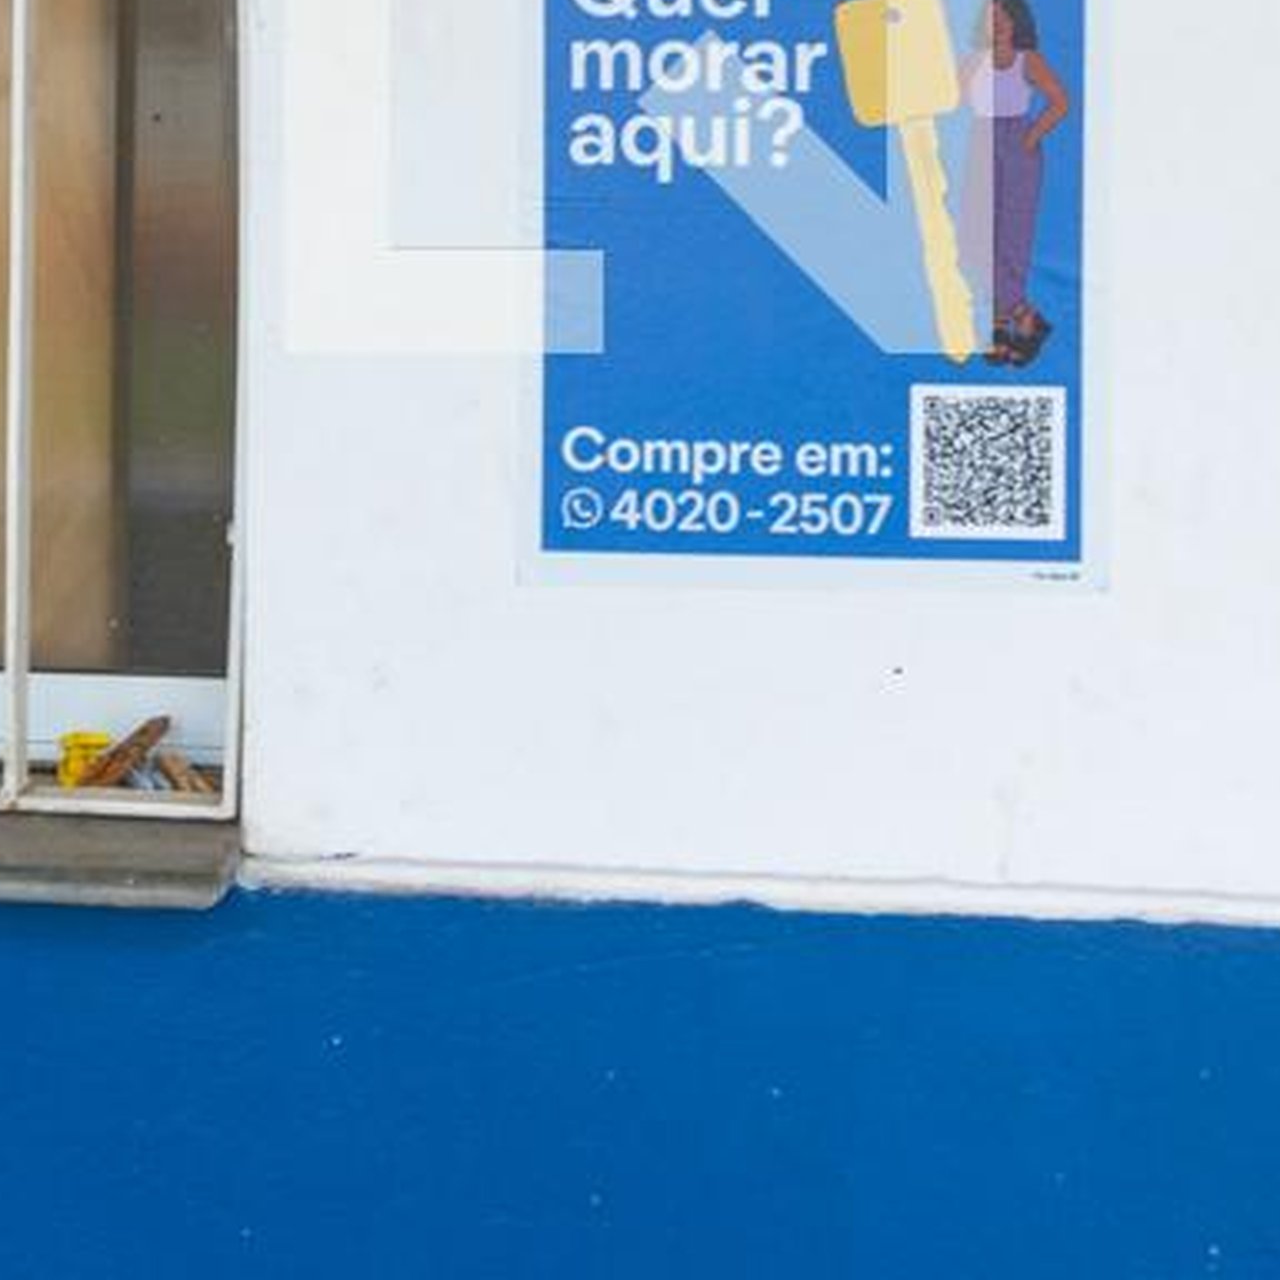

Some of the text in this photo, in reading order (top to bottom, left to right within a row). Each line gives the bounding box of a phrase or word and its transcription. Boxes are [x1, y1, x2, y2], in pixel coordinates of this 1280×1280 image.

[570, 36, 828, 94] morar
[568, 96, 805, 184] aqui?
[561, 425, 892, 484] Compre em:
